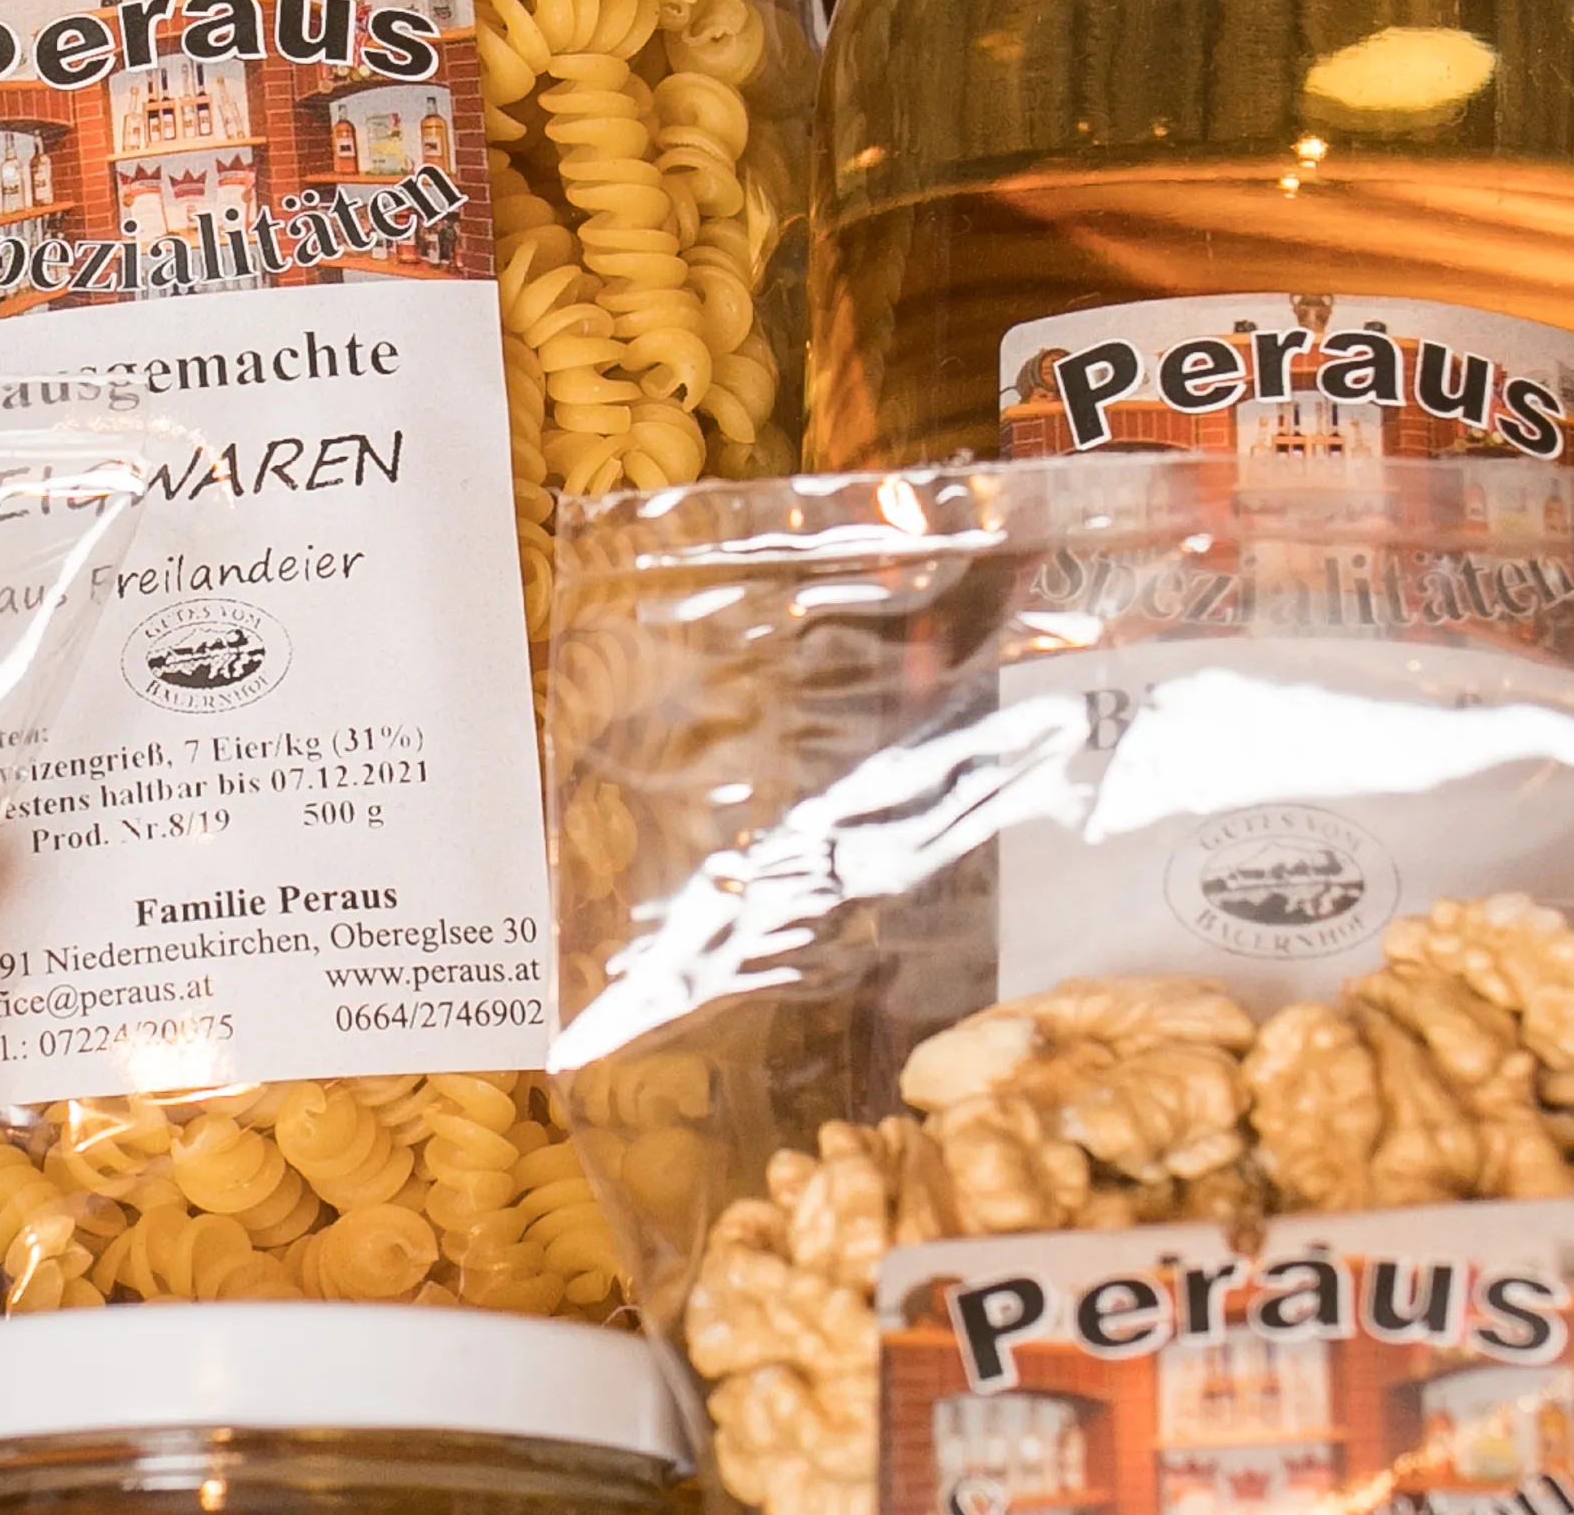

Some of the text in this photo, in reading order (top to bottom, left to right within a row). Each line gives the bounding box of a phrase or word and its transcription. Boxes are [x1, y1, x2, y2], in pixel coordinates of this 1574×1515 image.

[1053, 325, 1566, 459] Peraus
[91, 544, 366, 602] Freilandeier
[185, 739, 200, 764] 7
[212, 732, 323, 762] Eier/kg
[331, 723, 424, 759] (31%)
[101, 779, 208, 808] haltbar
[219, 772, 261, 796] bis
[271, 759, 428, 793] 07.12.2021
[32, 822, 109, 854] Prod.
[303, 800, 356, 827] 500
[368, 804, 385, 829] g
[134, 885, 399, 928] Familie Peraus
[44, 927, 321, 975] Niederneukirchen,
[331, 918, 494, 953] Obereglsee
[502, 916, 538, 945] 30
[324, 958, 542, 993] www.peraus.at
[336, 998, 545, 1033] 0664/2746902
[948, 1253, 1570, 1394] Peraus
